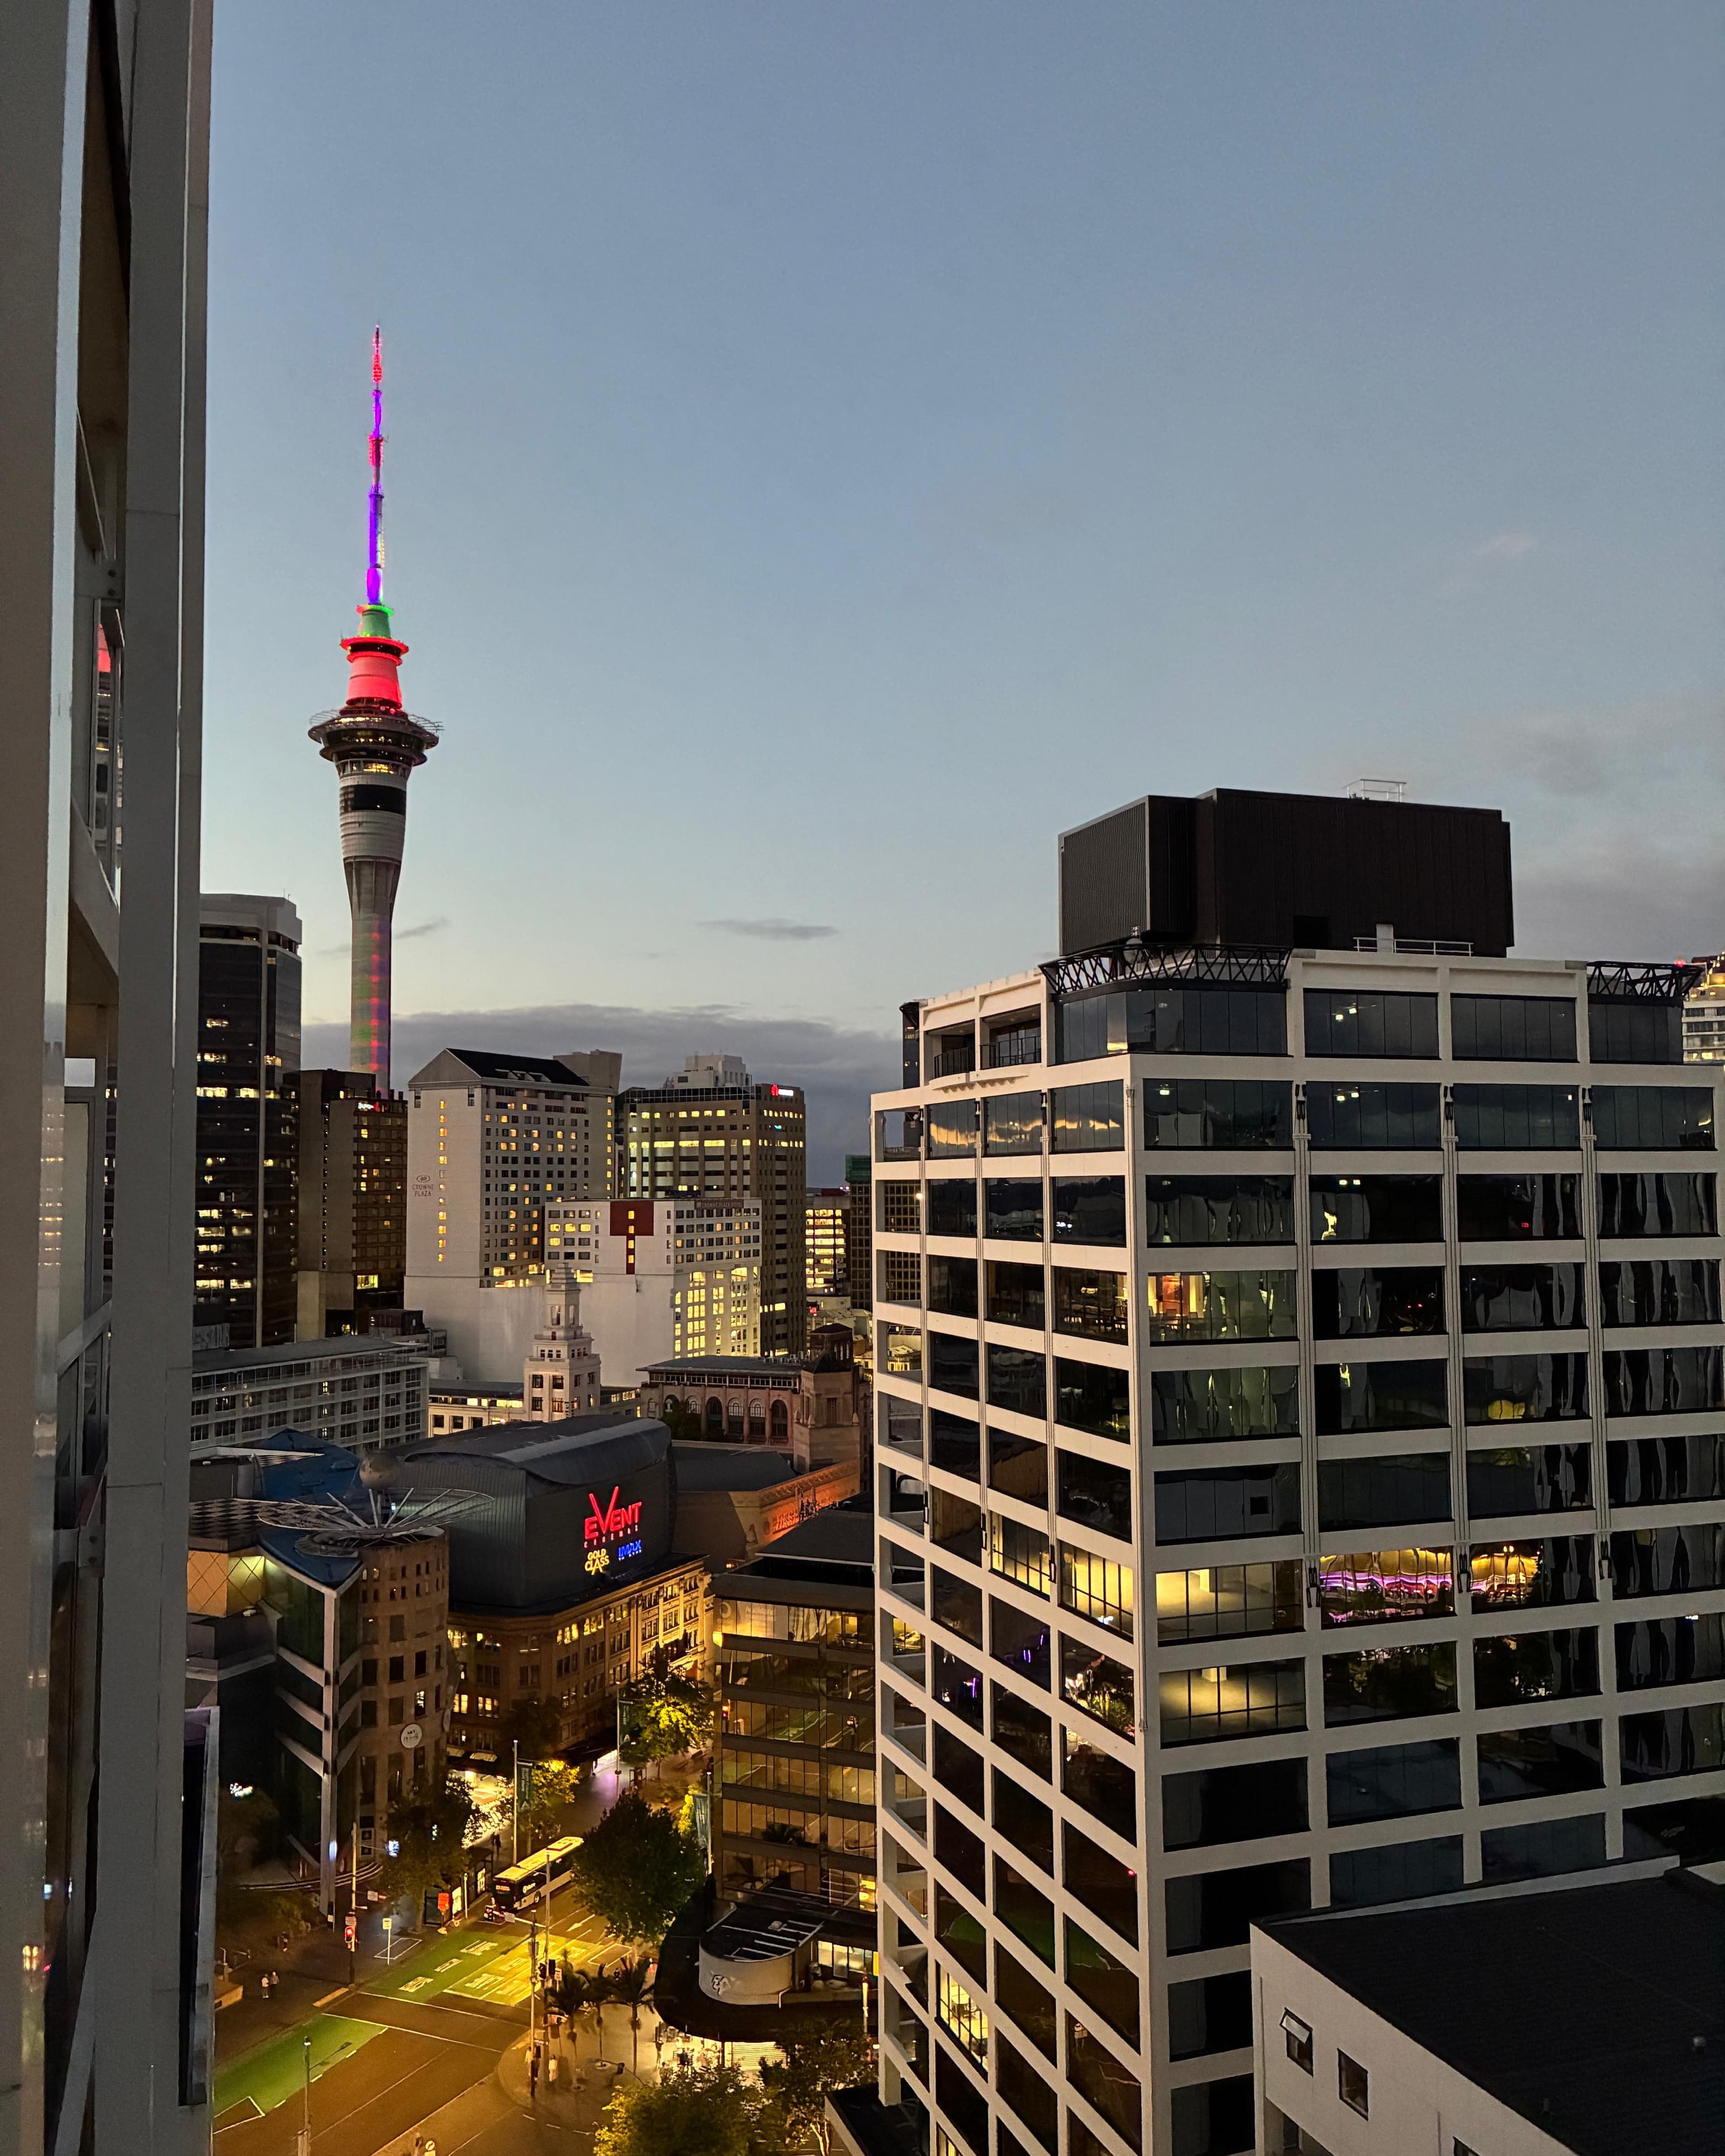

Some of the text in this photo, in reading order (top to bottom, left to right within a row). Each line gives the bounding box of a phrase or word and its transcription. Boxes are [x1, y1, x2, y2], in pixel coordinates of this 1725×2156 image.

[584, 1485, 642, 1540] EVENT
[588, 1548, 607, 1560] GOLD
[618, 1540, 642, 1558] IMAX
[584, 1555, 610, 1576] CLASS
